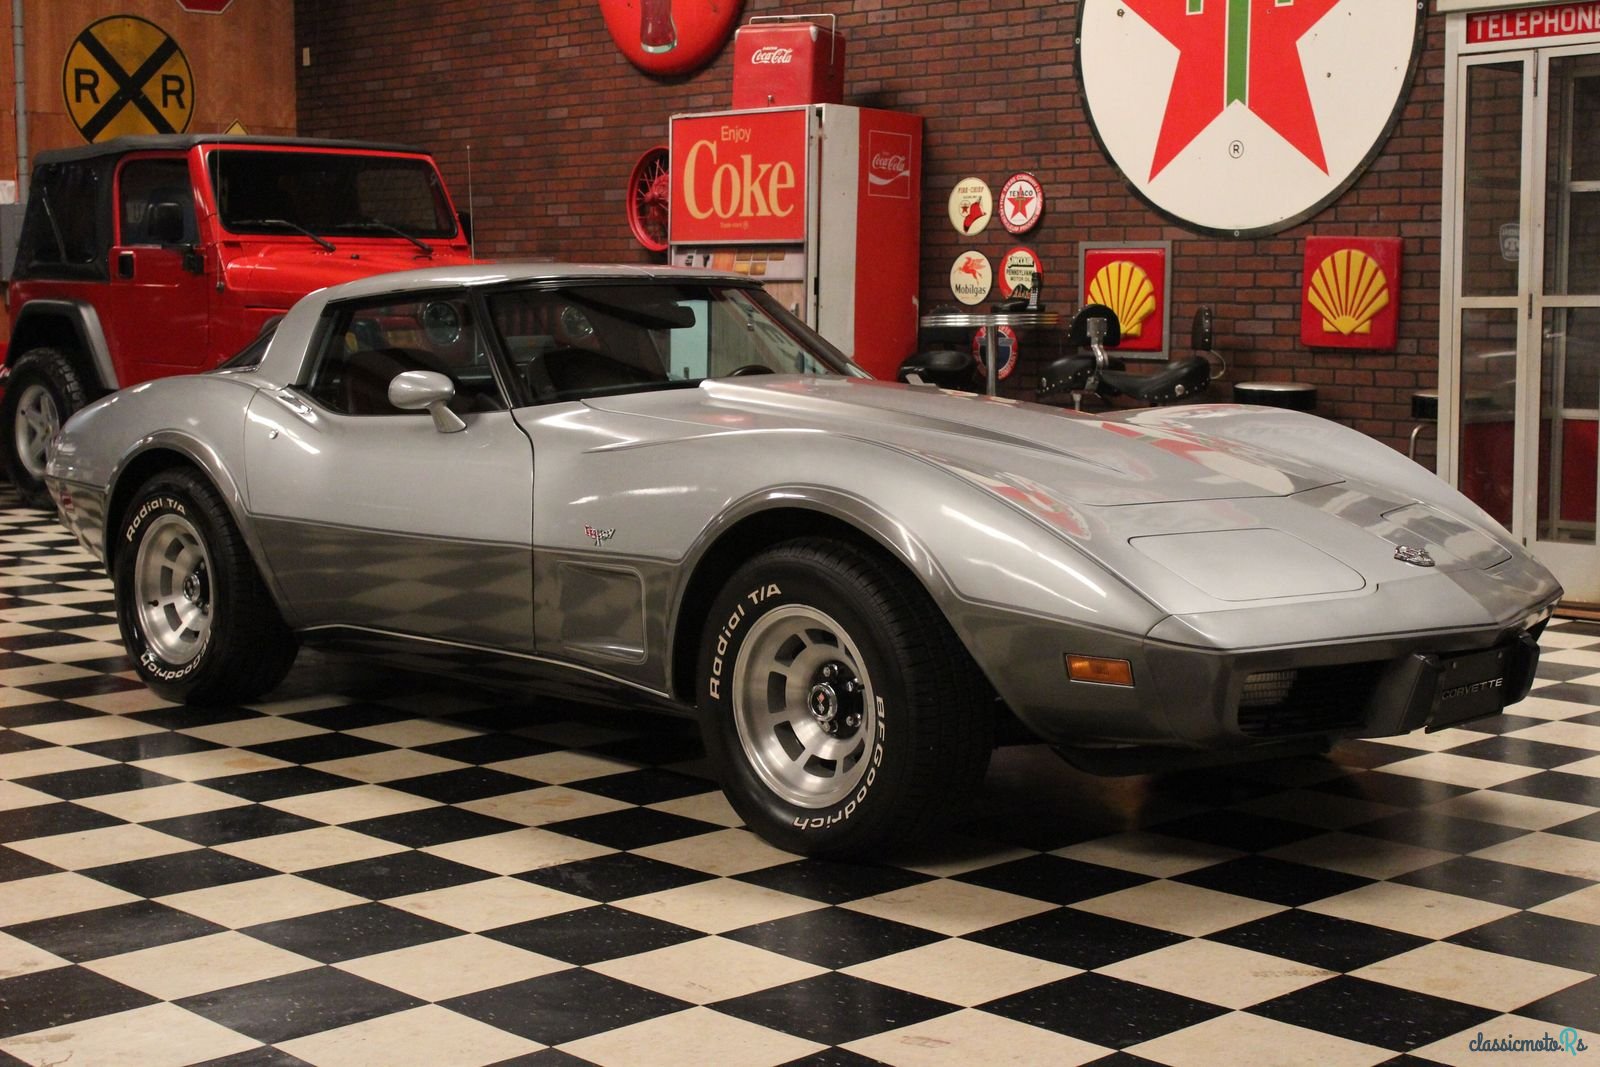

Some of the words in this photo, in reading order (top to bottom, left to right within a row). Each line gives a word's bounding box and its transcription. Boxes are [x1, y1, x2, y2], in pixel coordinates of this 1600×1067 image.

[74, 68, 100, 104] R
[161, 74, 185, 109] R
[721, 125, 751, 143] Enjoy
[683, 139, 795, 220] Coke
[955, 283, 986, 297] Mobilgas
[126, 497, 164, 543] Radial
[709, 604, 745, 700] Radial
[748, 583, 782, 605] T/A
[1442, 677, 1504, 700] CORVETTE
